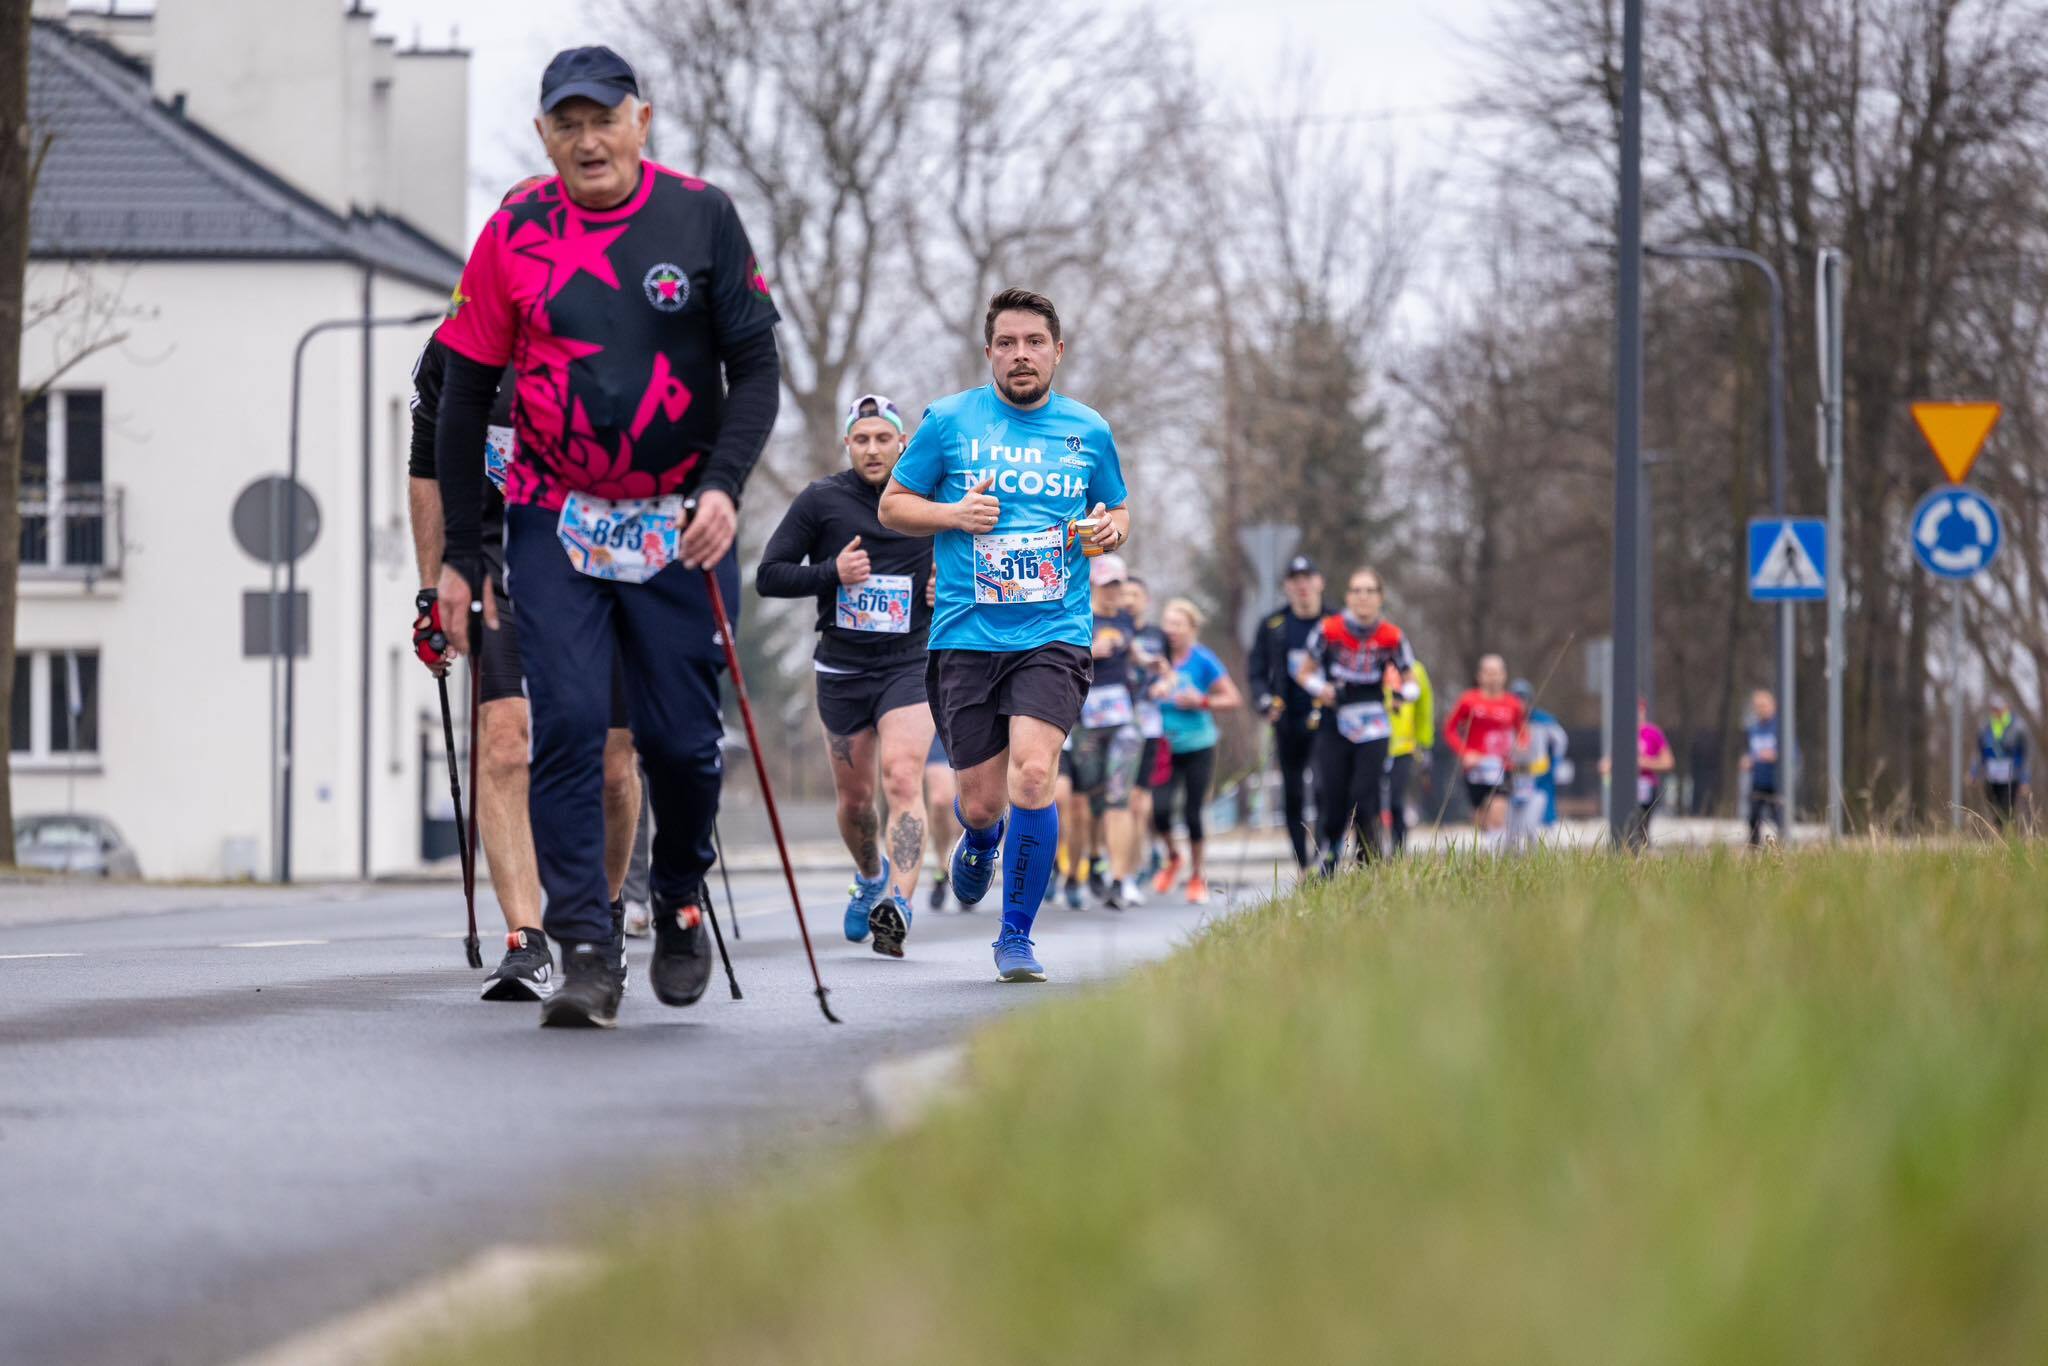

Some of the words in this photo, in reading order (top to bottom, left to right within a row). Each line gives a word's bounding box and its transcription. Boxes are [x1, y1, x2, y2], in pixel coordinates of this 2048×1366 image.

[971, 439, 979, 461] I
[990, 445, 1042, 464] run
[964, 469, 1085, 498] NICOSIA
[593, 519, 643, 551] 893
[1001, 557, 1039, 580] 315
[858, 593, 888, 612] 676
